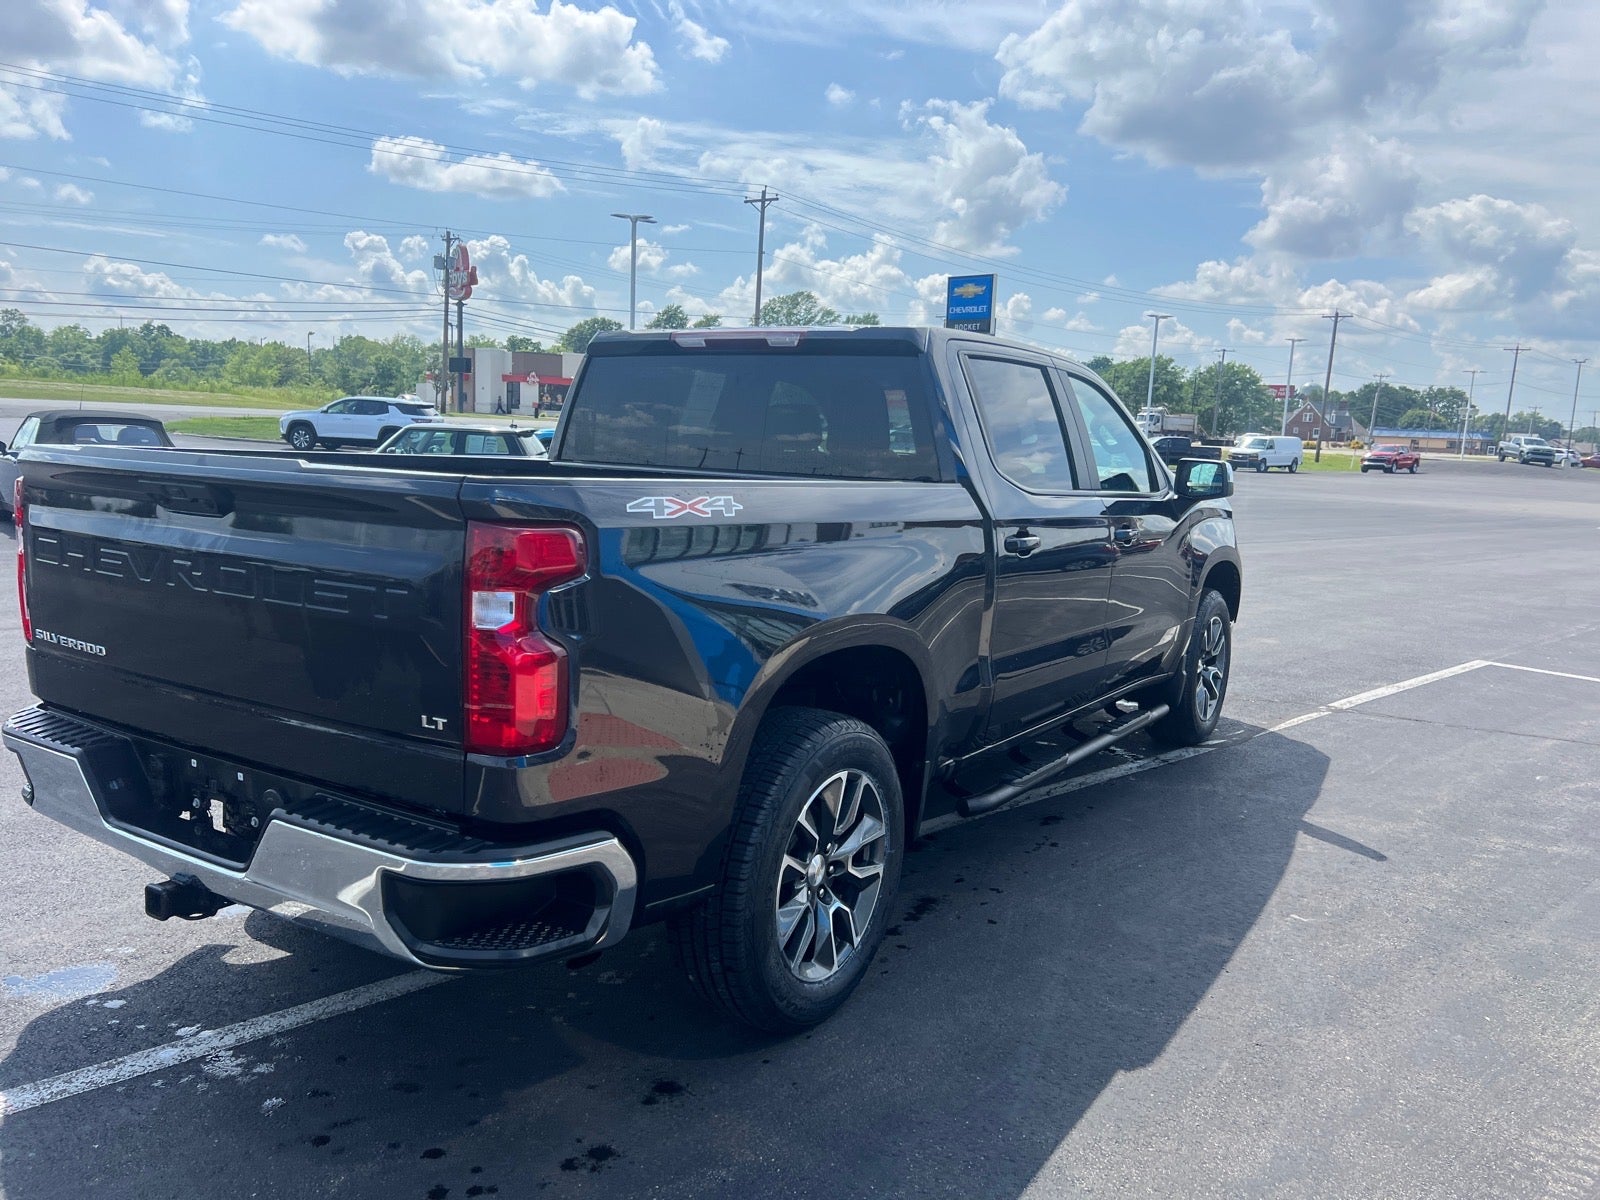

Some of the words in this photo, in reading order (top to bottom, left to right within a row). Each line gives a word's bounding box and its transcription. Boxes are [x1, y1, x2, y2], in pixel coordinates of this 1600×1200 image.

[949, 305, 988, 314] CHEVROLET
[34, 536, 409, 619] CHEVROLET
[35, 628, 107, 657] SILVERADO
[421, 714, 448, 731] LT
